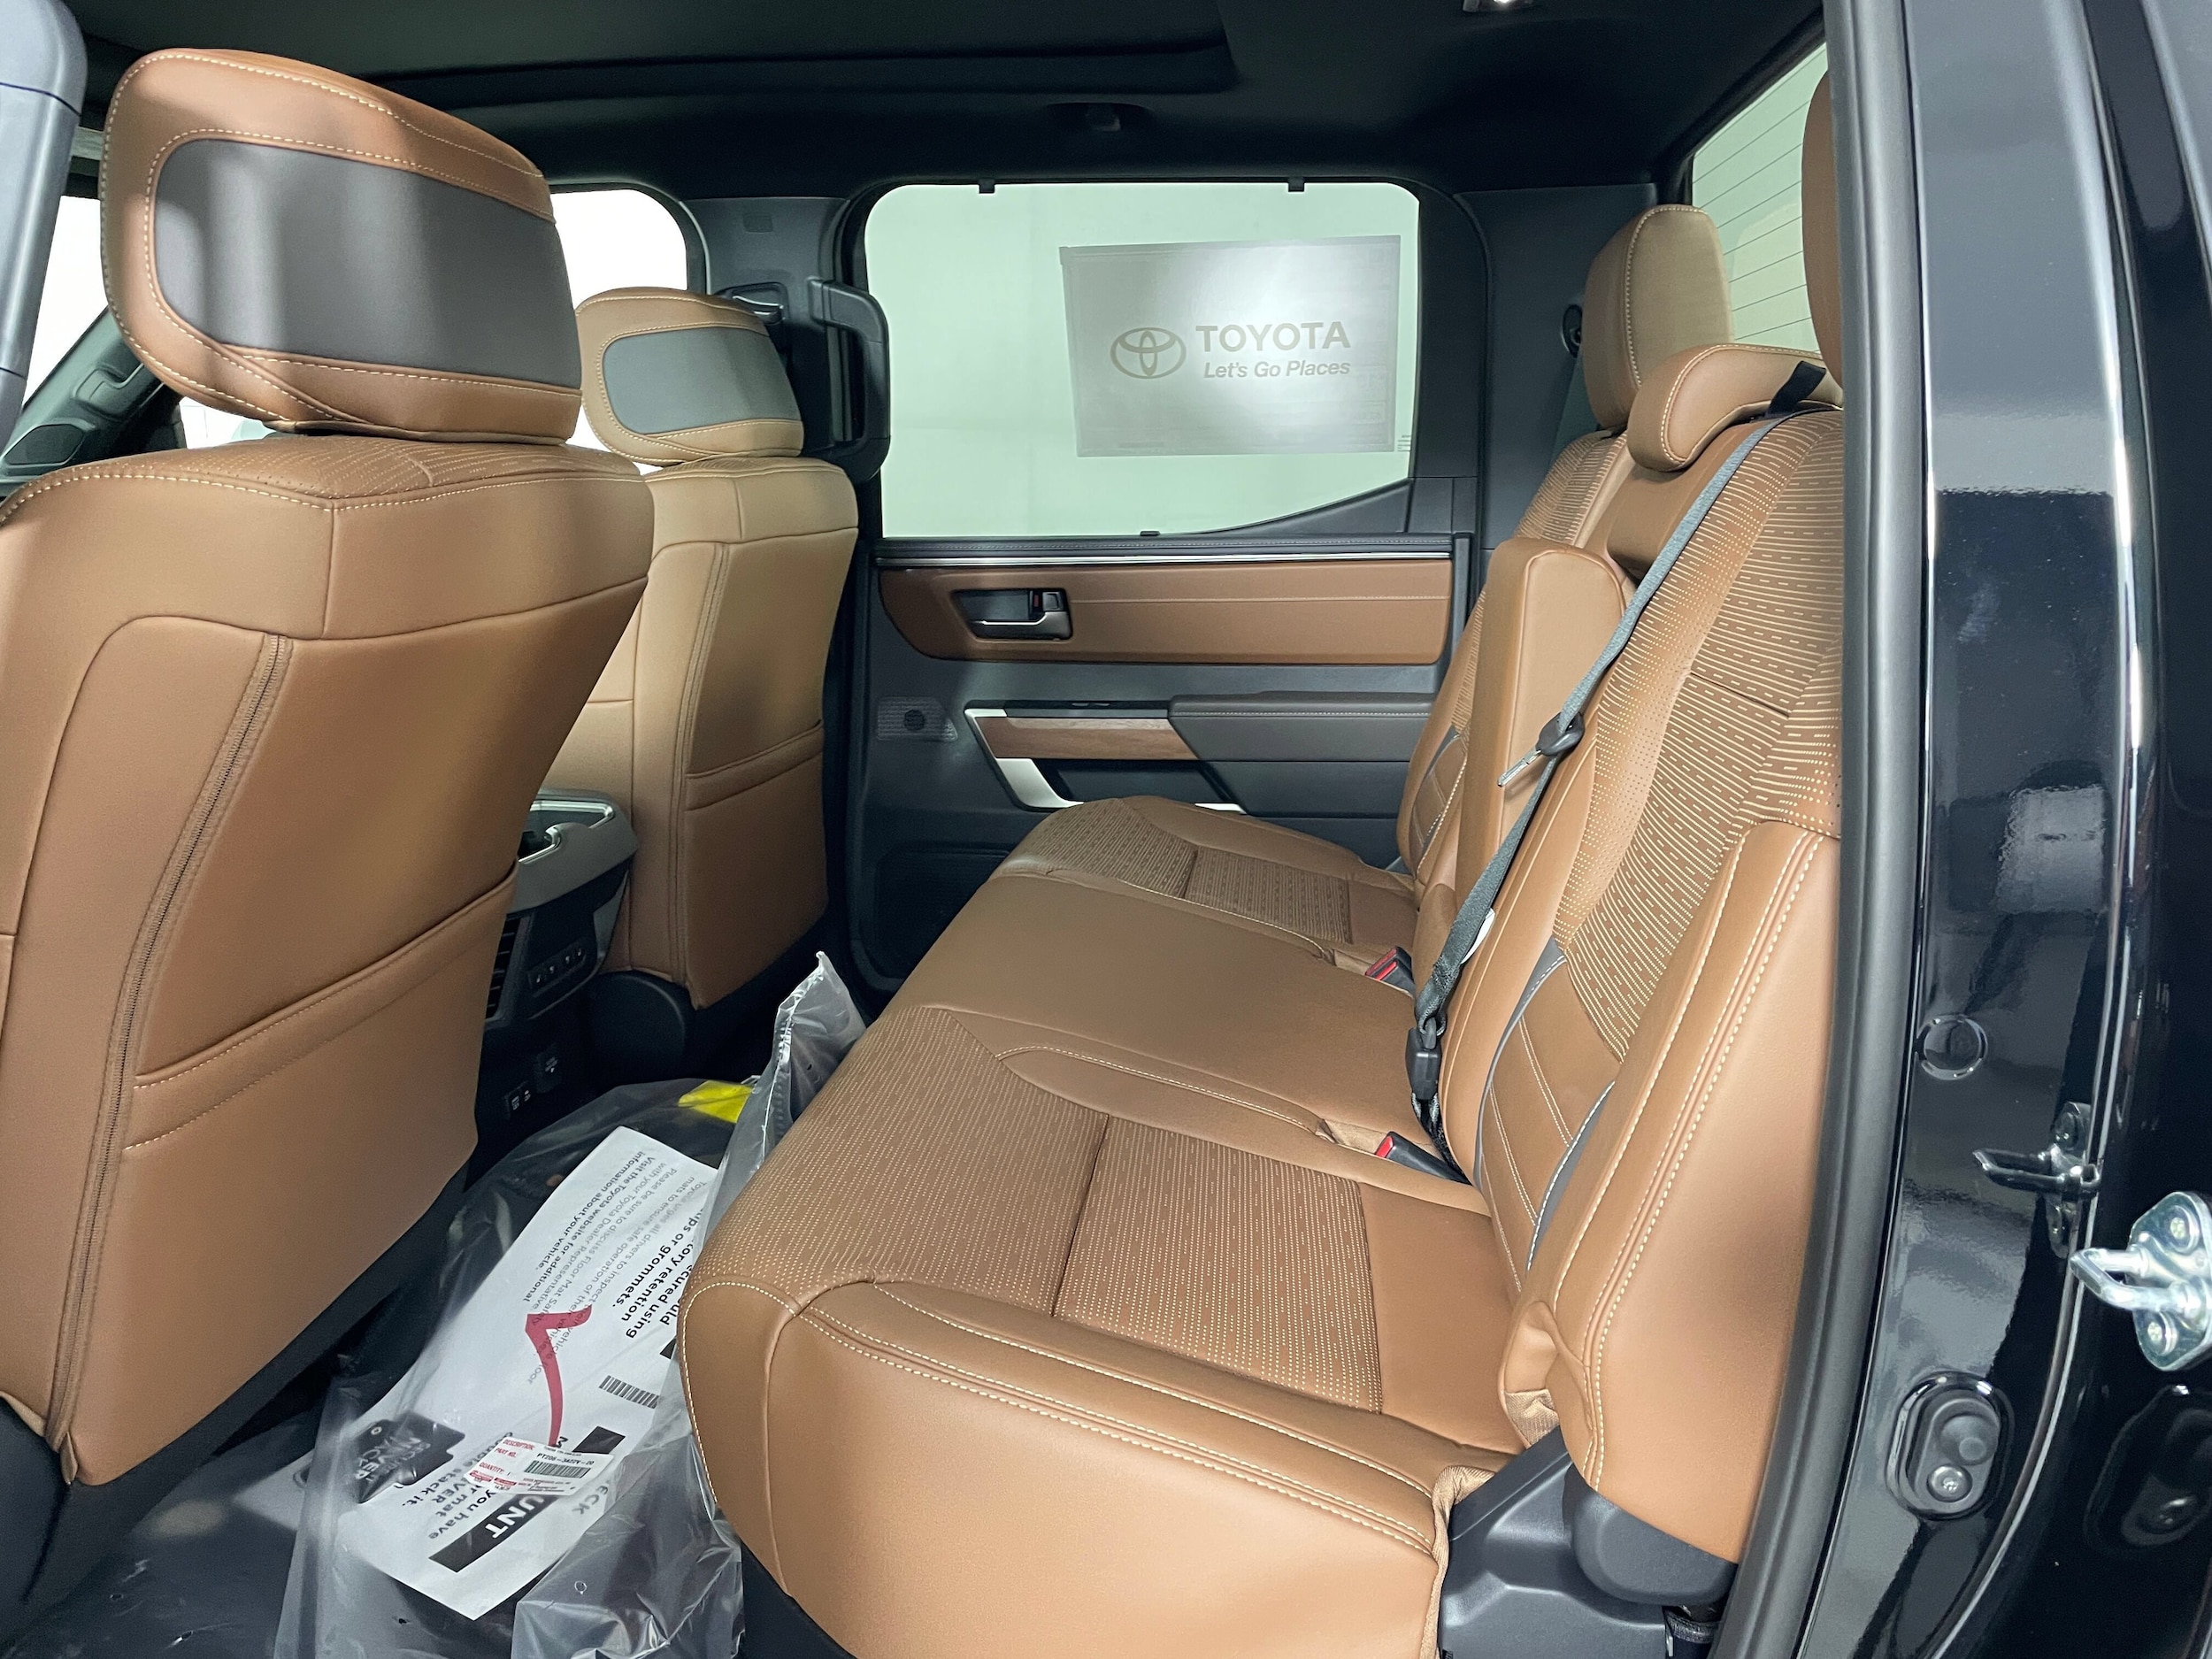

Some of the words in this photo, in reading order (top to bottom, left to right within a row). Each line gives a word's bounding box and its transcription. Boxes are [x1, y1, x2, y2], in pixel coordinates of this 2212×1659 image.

[1195, 321, 1351, 353] TOYOTA
[1203, 362, 1248, 378] Let's
[1254, 361, 1281, 377] Go
[1286, 359, 1351, 376] Places
[601, 1151, 646, 1193] information
[634, 1156, 656, 1172] Visit
[649, 1163, 667, 1178] with
[623, 1171, 639, 1184] the
[633, 1176, 651, 1194] your
[650, 1167, 678, 1190] Please
[675, 1176, 695, 1194] mats
[578, 1192, 603, 1216] about
[598, 1185, 627, 1209] Toyota
[608, 1194, 637, 1217] Toyota
[640, 1189, 655, 1201] be
[667, 1194, 680, 1202] to
[624, 1200, 642, 1216] sure
[642, 1202, 669, 1225] ensure
[563, 1215, 581, 1237] your
[571, 1209, 601, 1240] website
[584, 1217, 611, 1245] Dealer
[615, 1216, 627, 1225] to
[649, 1223, 662, 1235] all
[588, 1225, 617, 1255] discuss
[626, 1225, 644, 1242] safe
[671, 1233, 684, 1247] or
[535, 1238, 565, 1270] vehicle.
[560, 1241, 574, 1256] for
[625, 1233, 652, 1260] drivers
[570, 1256, 592, 1279] Floor
[591, 1242, 628, 1283] operation
[616, 1260, 628, 1270] to
[522, 1256, 561, 1302] additional
[554, 1279, 573, 1297] Mat
[588, 1271, 620, 1303] inspect
[612, 1245, 672, 1308] grommets.
[657, 1264, 693, 1304] ecured
[583, 1284, 593, 1295] of
[621, 1266, 673, 1322] retention
[530, 1297, 557, 1327] Safety
[626, 1303, 660, 1339] using
[659, 1302, 681, 1325] uld
[545, 1326, 573, 1361] vehicle
[462, 1432, 513, 1468] ouble
[420, 1468, 462, 1495] stack
[431, 1477, 470, 1504] VER
[402, 1495, 424, 1507] it.
[434, 1494, 468, 1517] mat
[466, 1489, 496, 1512] you
[572, 1485, 611, 1515] ECK
[428, 1512, 469, 1540] have
[485, 1493, 544, 1539] UNT
